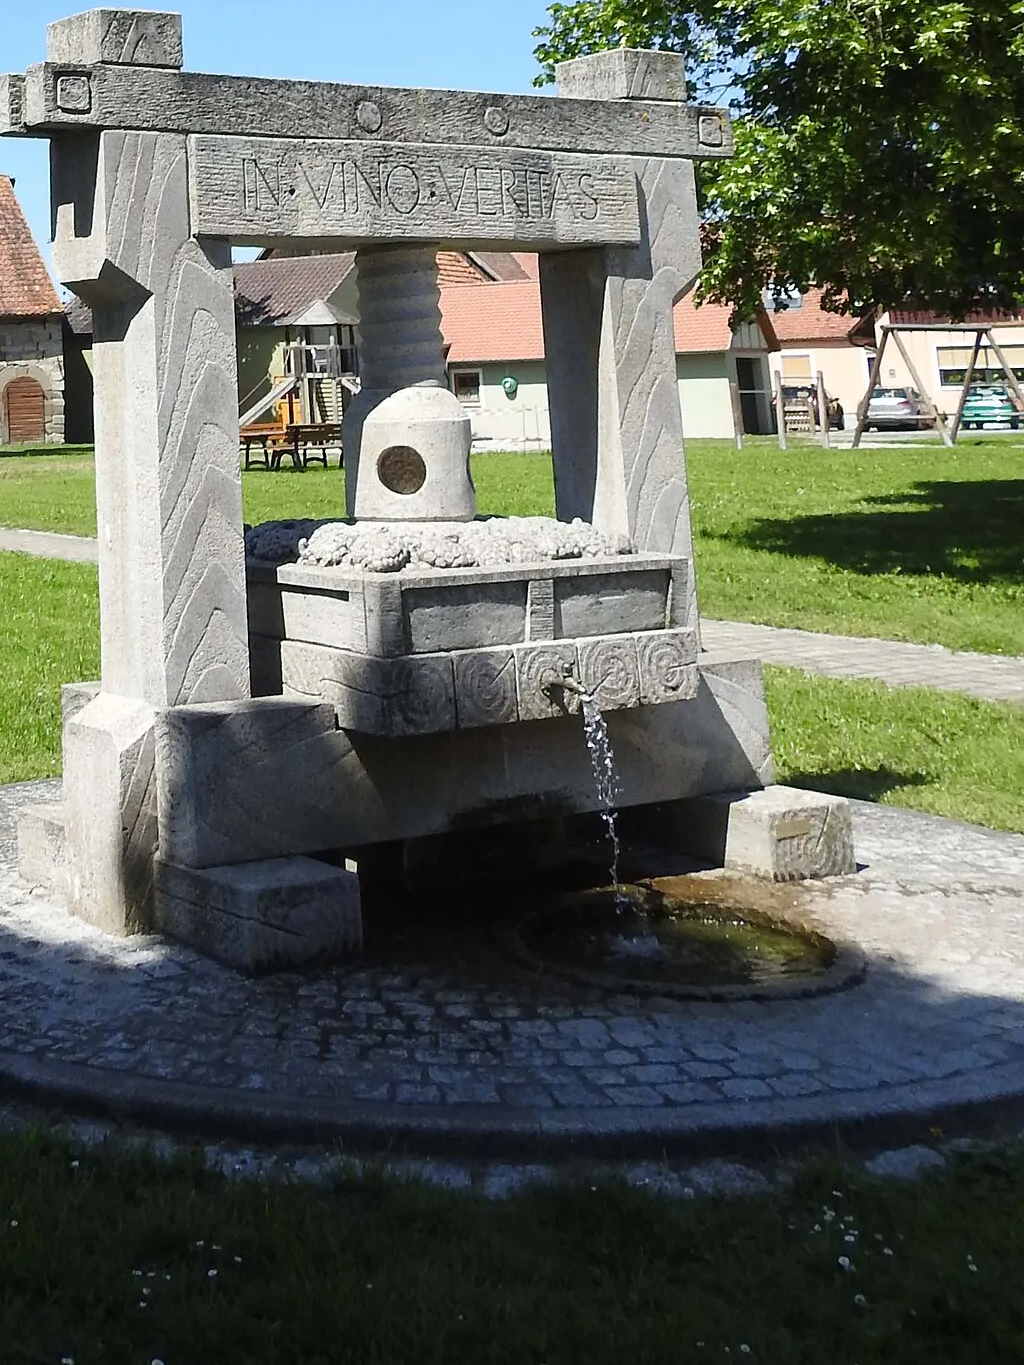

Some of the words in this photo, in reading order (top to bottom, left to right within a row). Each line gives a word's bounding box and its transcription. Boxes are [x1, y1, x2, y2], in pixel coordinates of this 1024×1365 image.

[242, 158, 280, 211] IN
[297, 160, 421, 214] VINO
[436, 165, 600, 221] VERITAS
